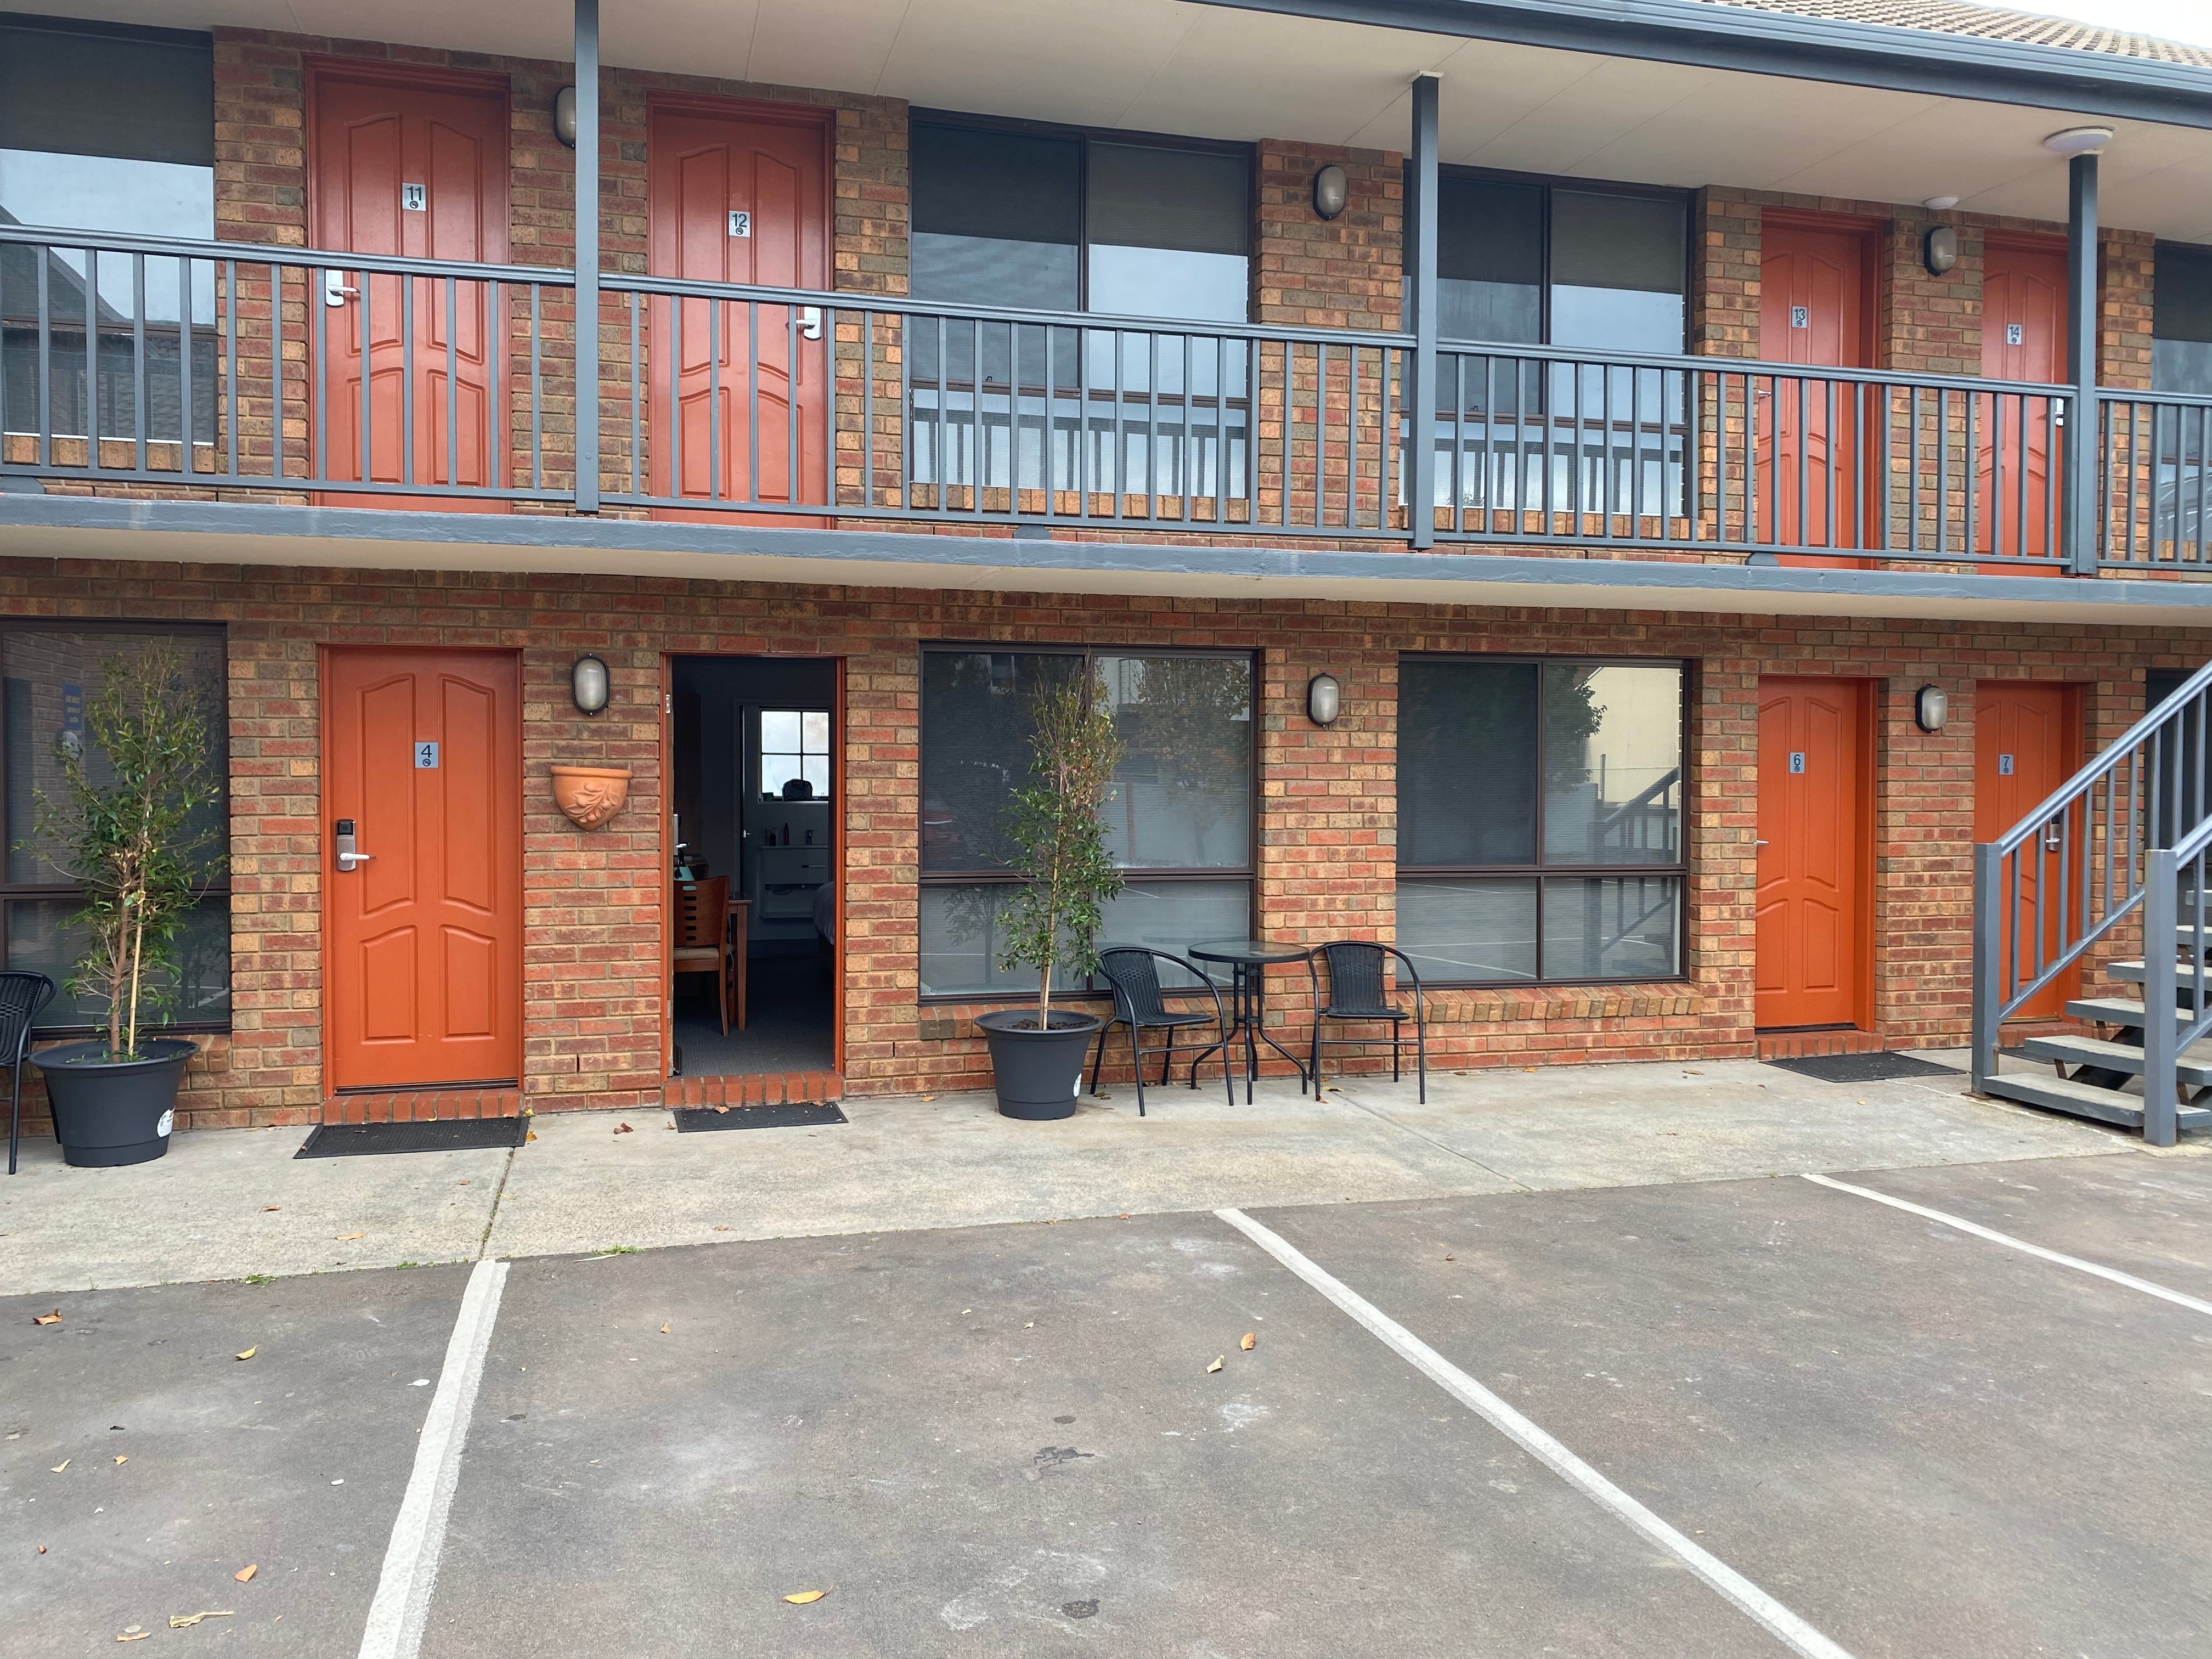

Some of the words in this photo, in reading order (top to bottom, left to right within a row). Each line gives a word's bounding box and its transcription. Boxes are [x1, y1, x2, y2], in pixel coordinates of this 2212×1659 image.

[407, 186, 422, 201] 11
[732, 213, 747, 228] 12
[1795, 308, 1805, 320] 13
[2010, 326, 2019, 337] 14
[421, 744, 432, 758] 4
[1794, 754, 1801, 765] 6
[2004, 756, 2010, 767] 7
